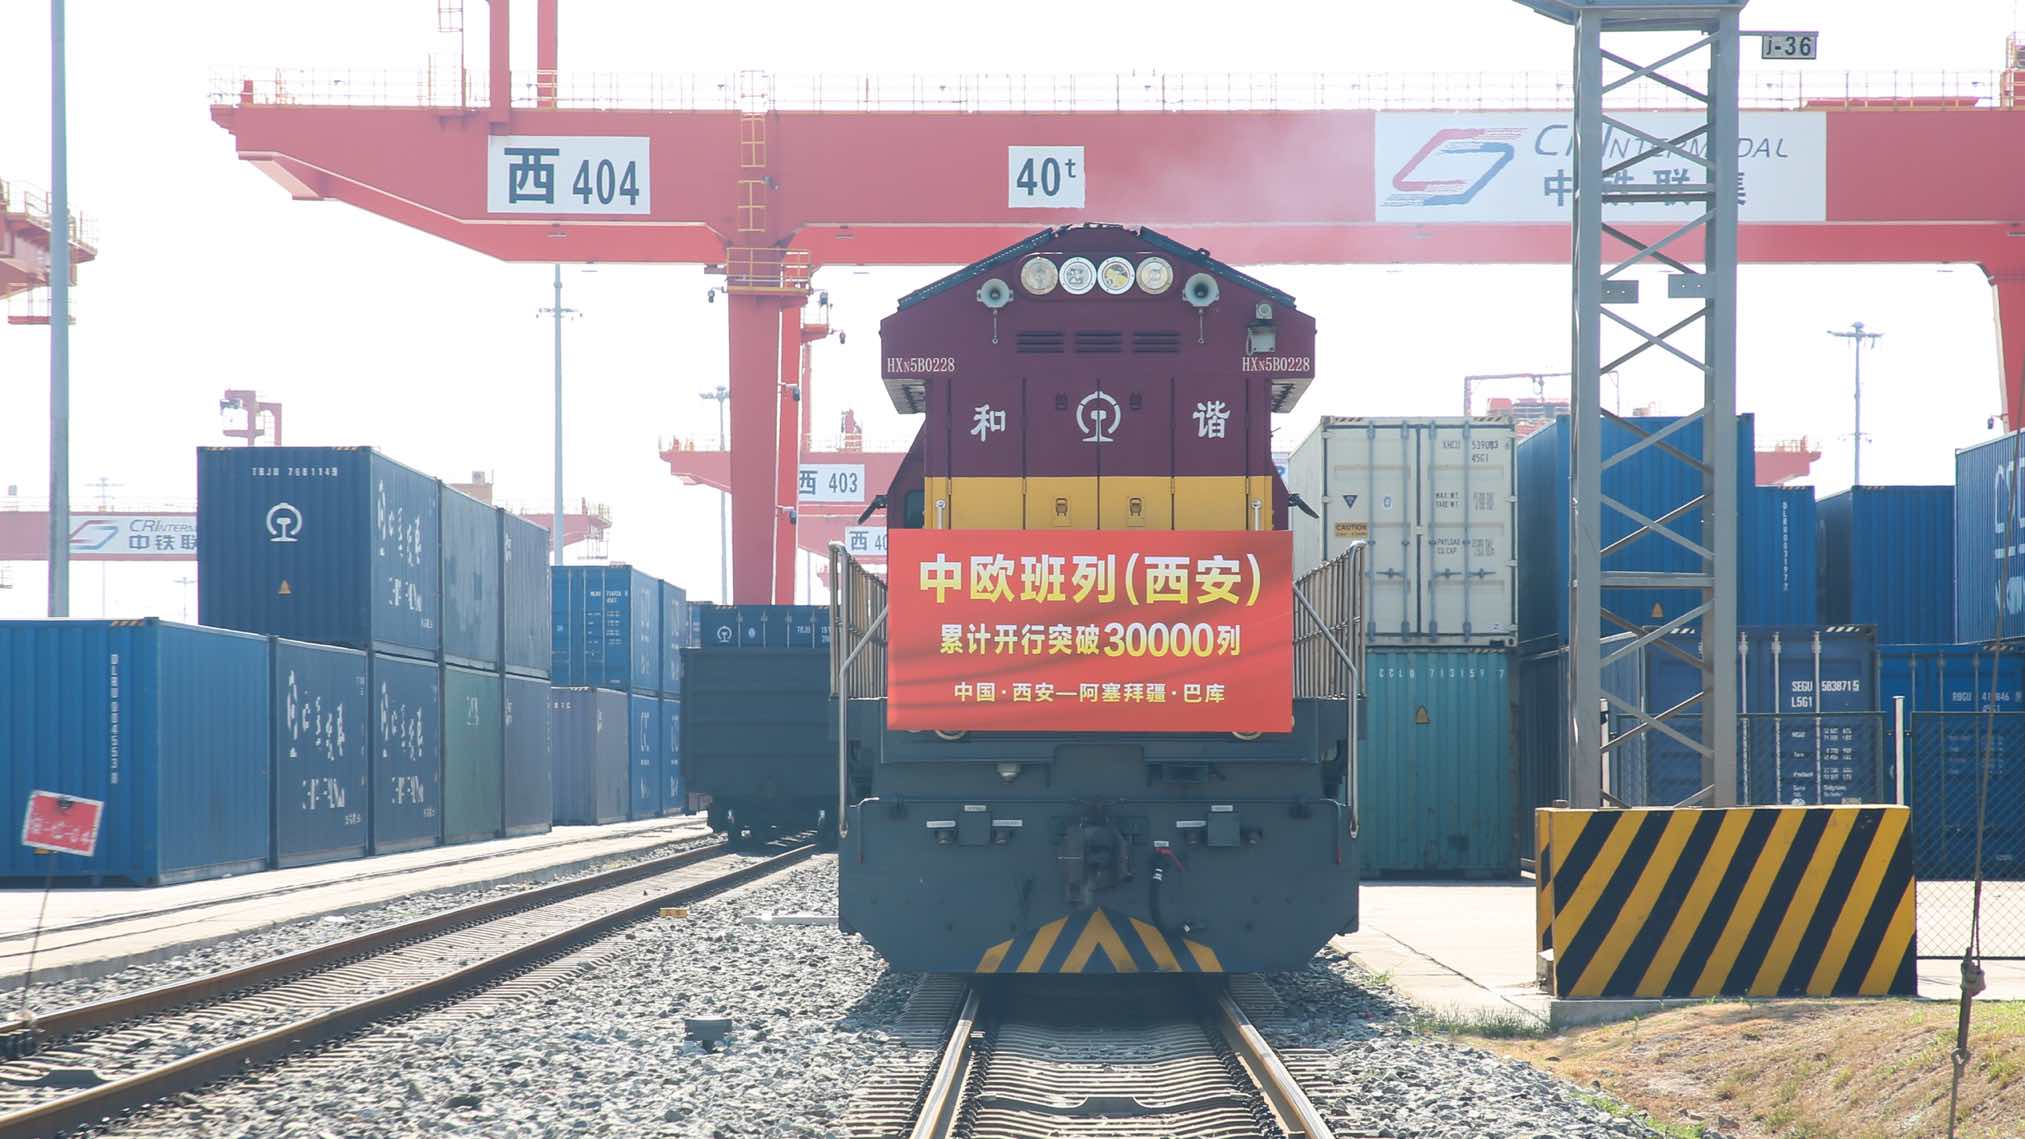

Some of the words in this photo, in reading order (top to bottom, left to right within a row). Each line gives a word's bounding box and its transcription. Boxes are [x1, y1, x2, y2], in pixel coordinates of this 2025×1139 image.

[504, 148, 560, 204] 西
[572, 159, 640, 205] 404
[970, 403, 1006, 441] 和
[1193, 400, 1230, 439] 谐
[799, 470, 818, 495] 西
[829, 472, 858, 493] 403
[849, 531, 869, 551] 西
[919, 552, 1261, 606] 中欧班列(西安)
[940, 622, 1241, 658] 累计开行突破30000列
[1792, 681, 1813, 692] SEGU
[1792, 697, 1813, 708] L5G1
